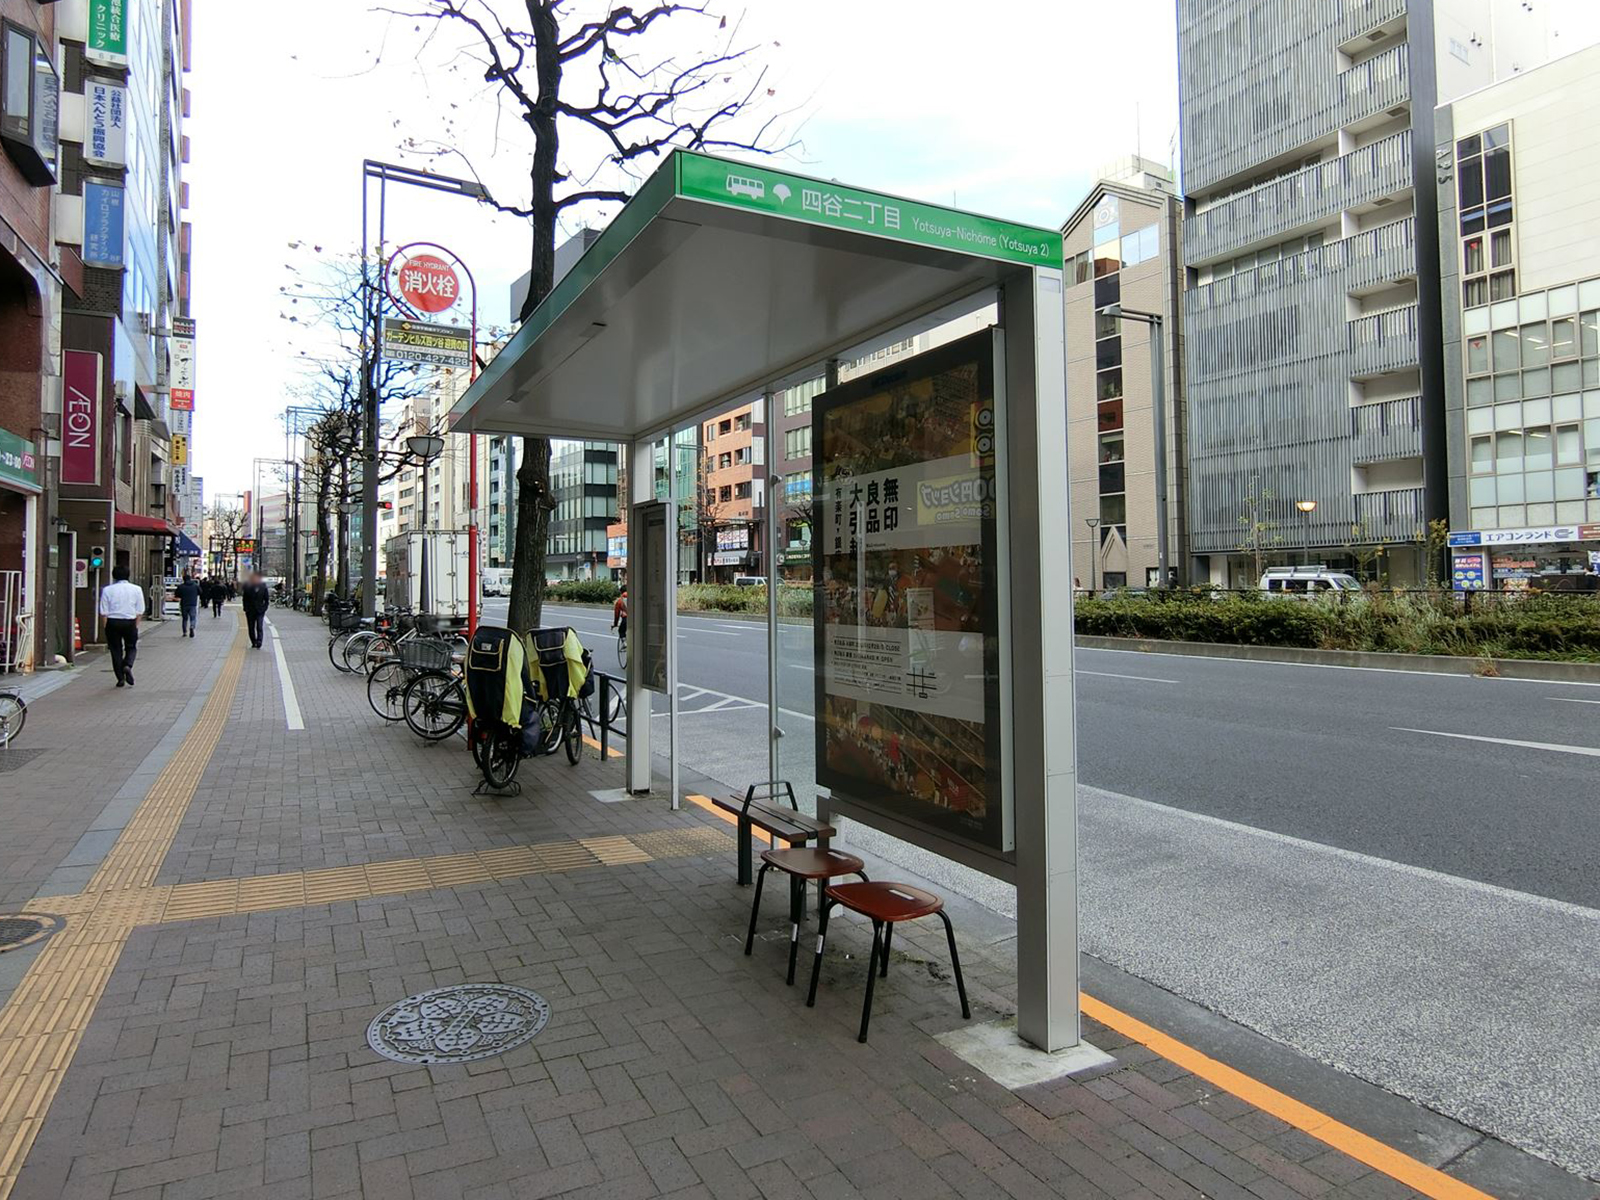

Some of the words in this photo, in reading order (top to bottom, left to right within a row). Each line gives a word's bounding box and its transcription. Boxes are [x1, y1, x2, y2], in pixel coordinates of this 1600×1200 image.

[96, 4, 106, 48] クリニック
[802, 188, 900, 230] 四谷二丁目
[999, 233, 1038, 256] (Yotsuya
[1040, 242, 1050, 258] 2)
[404, 269, 455, 298] 消火栓
[423, 262, 450, 272] HYDRANT
[866, 480, 880, 533] 良品
[884, 478, 899, 531] 無印
[1485, 530, 1552, 542] エアコンランド
